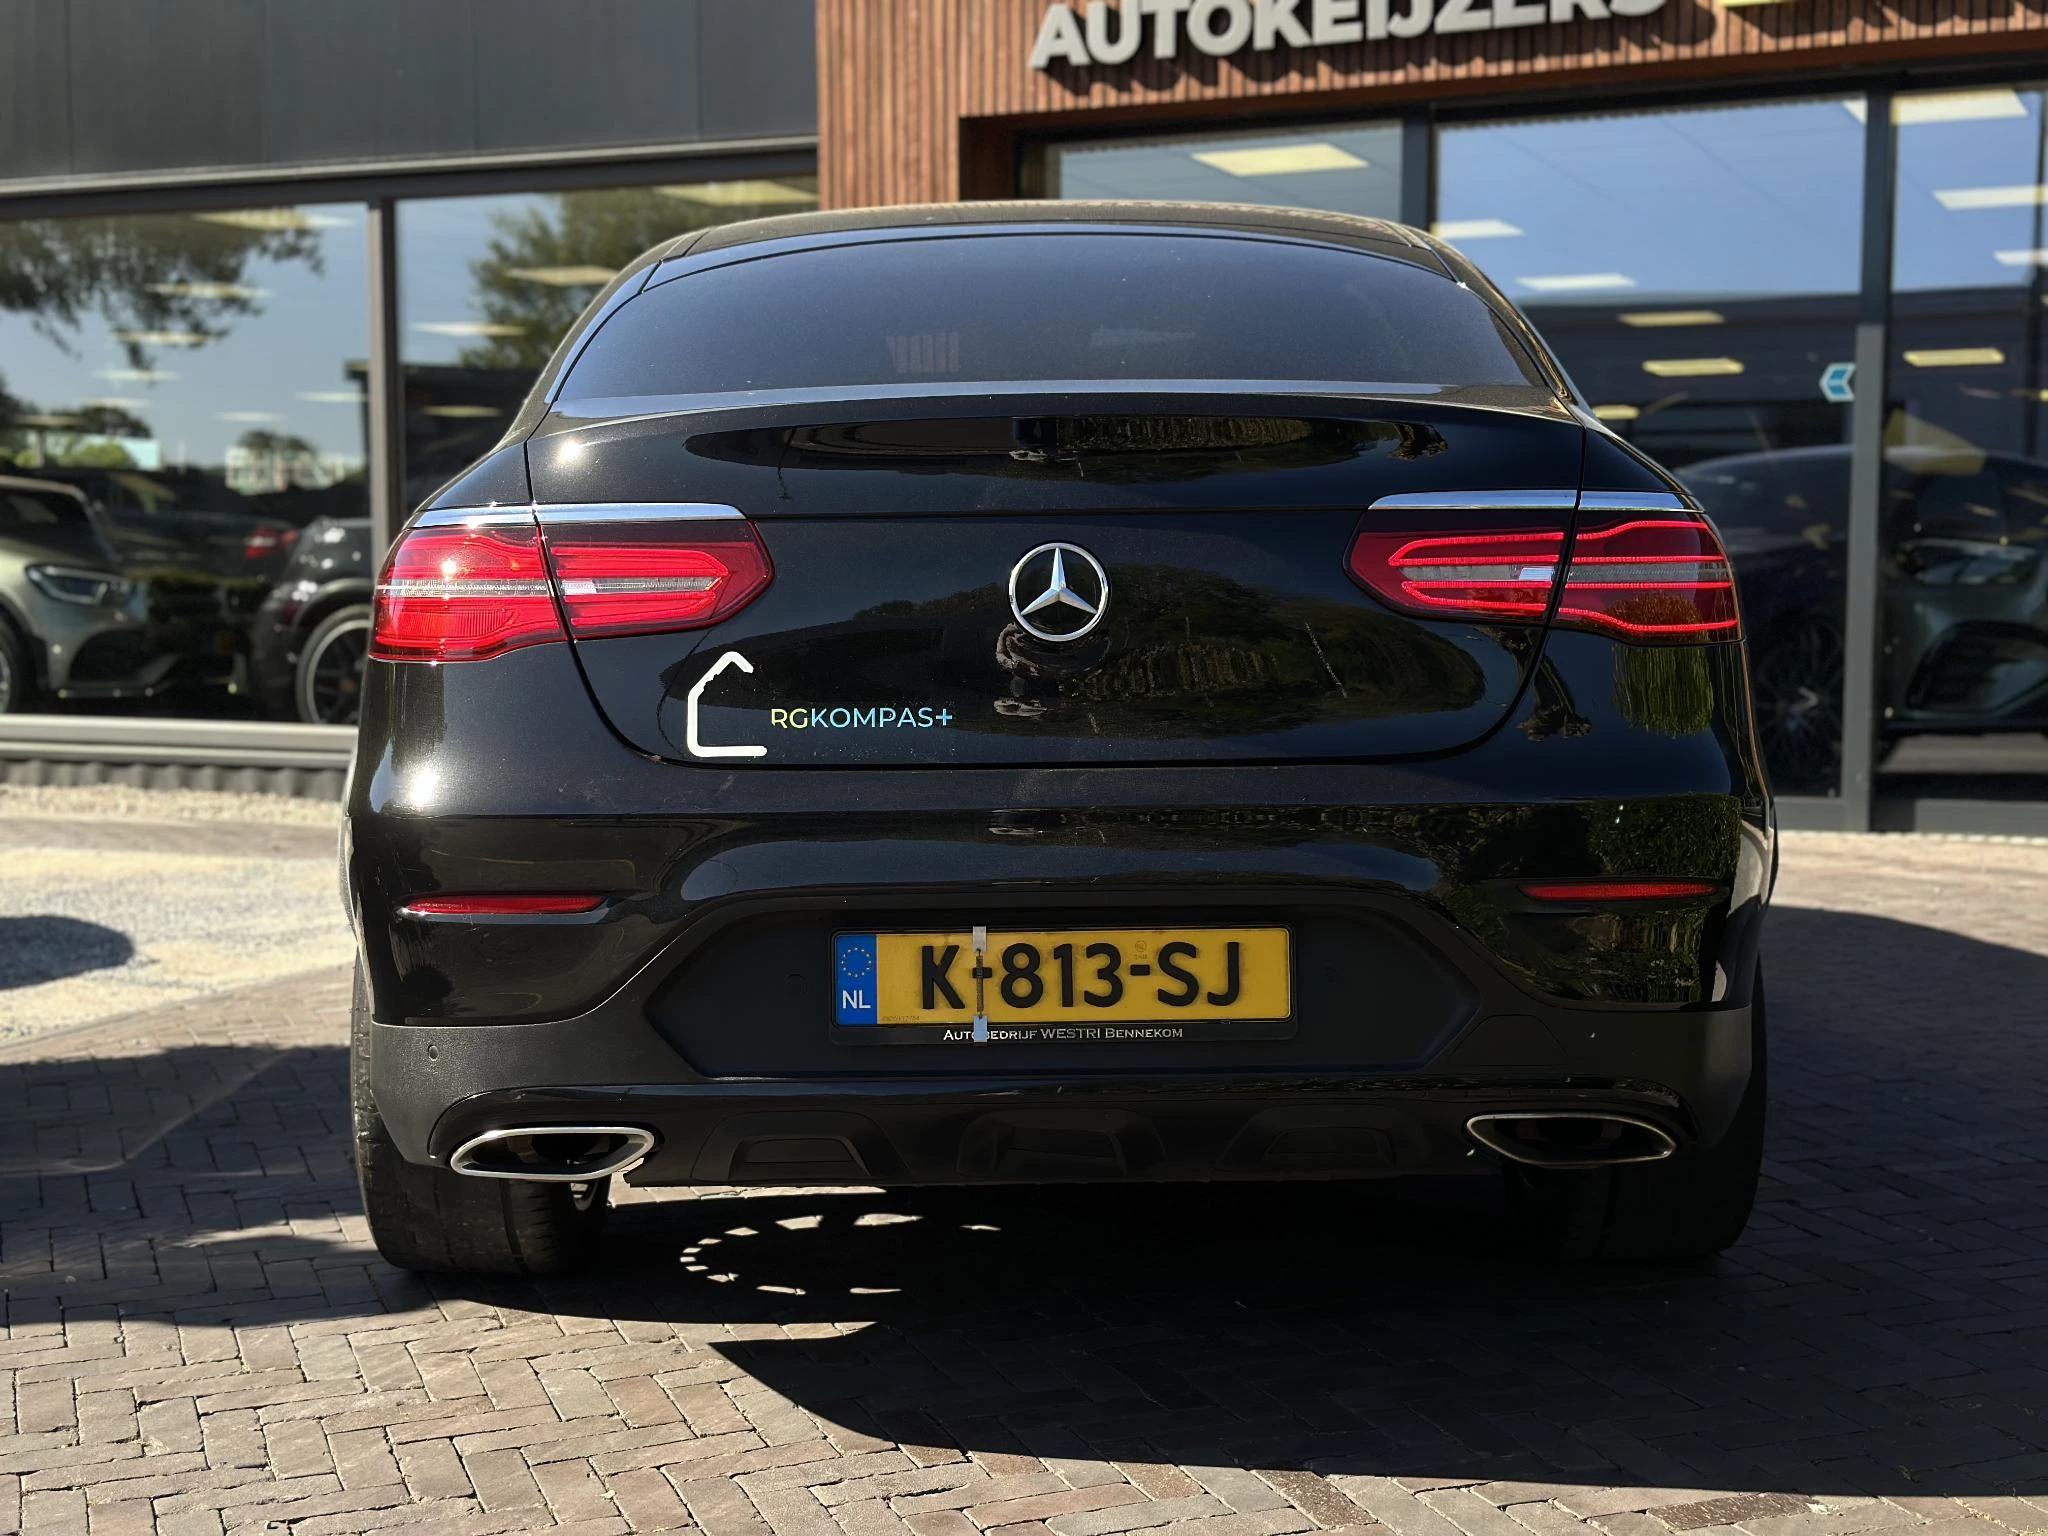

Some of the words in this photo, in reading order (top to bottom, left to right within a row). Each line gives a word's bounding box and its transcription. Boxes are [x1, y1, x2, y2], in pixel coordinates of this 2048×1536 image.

[1027, 0, 1662, 68] AUTOKEIJZ
[771, 707, 953, 729] RGKOMPAS+
[921, 941, 1240, 1011] K-813-SJ
[841, 990, 872, 1010] NL
[943, 1029, 1037, 1041] AUTEDRIJF
[1040, 1027, 1101, 1039] WESTRI
